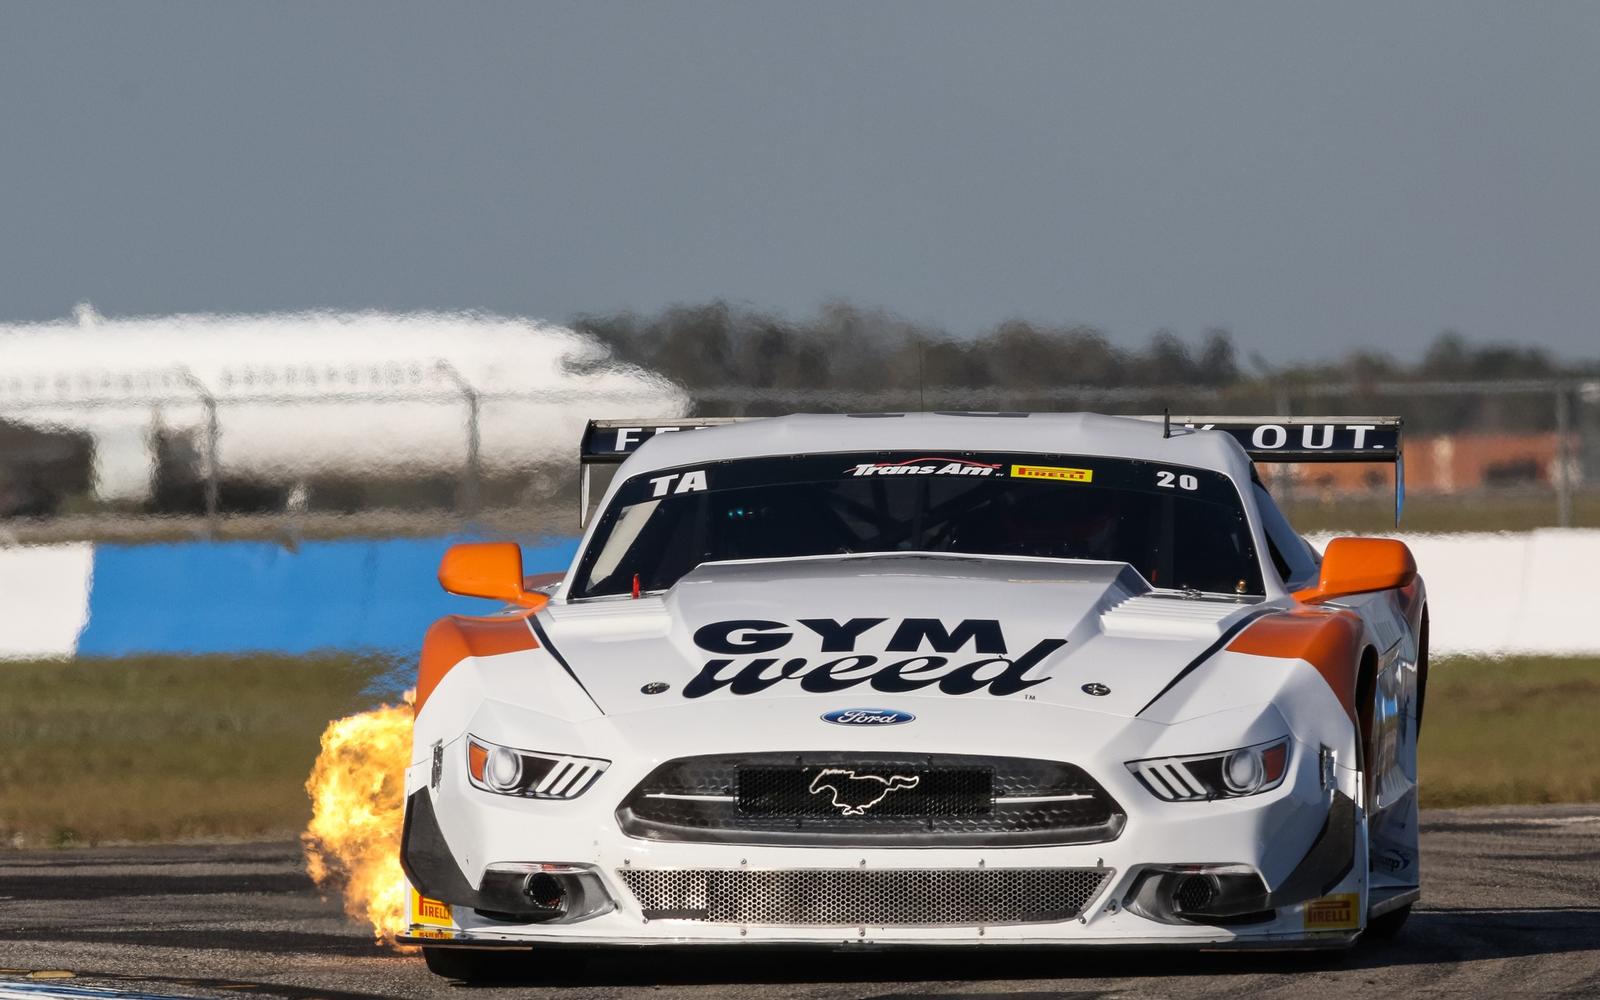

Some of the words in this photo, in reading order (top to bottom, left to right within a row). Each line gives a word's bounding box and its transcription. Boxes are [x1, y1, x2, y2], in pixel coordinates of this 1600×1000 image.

[1252, 424, 1385, 449] OUT.
[853, 464, 937, 476] Trans
[935, 463, 993, 476] Am
[1018, 468, 1086, 480] PIRELLI
[1156, 471, 1198, 490] 20
[649, 470, 708, 497] TA
[693, 617, 1008, 654] GYM
[682, 638, 1068, 699] weed
[837, 710, 898, 723] Ford
[1308, 901, 1352, 923] PIRELLI
